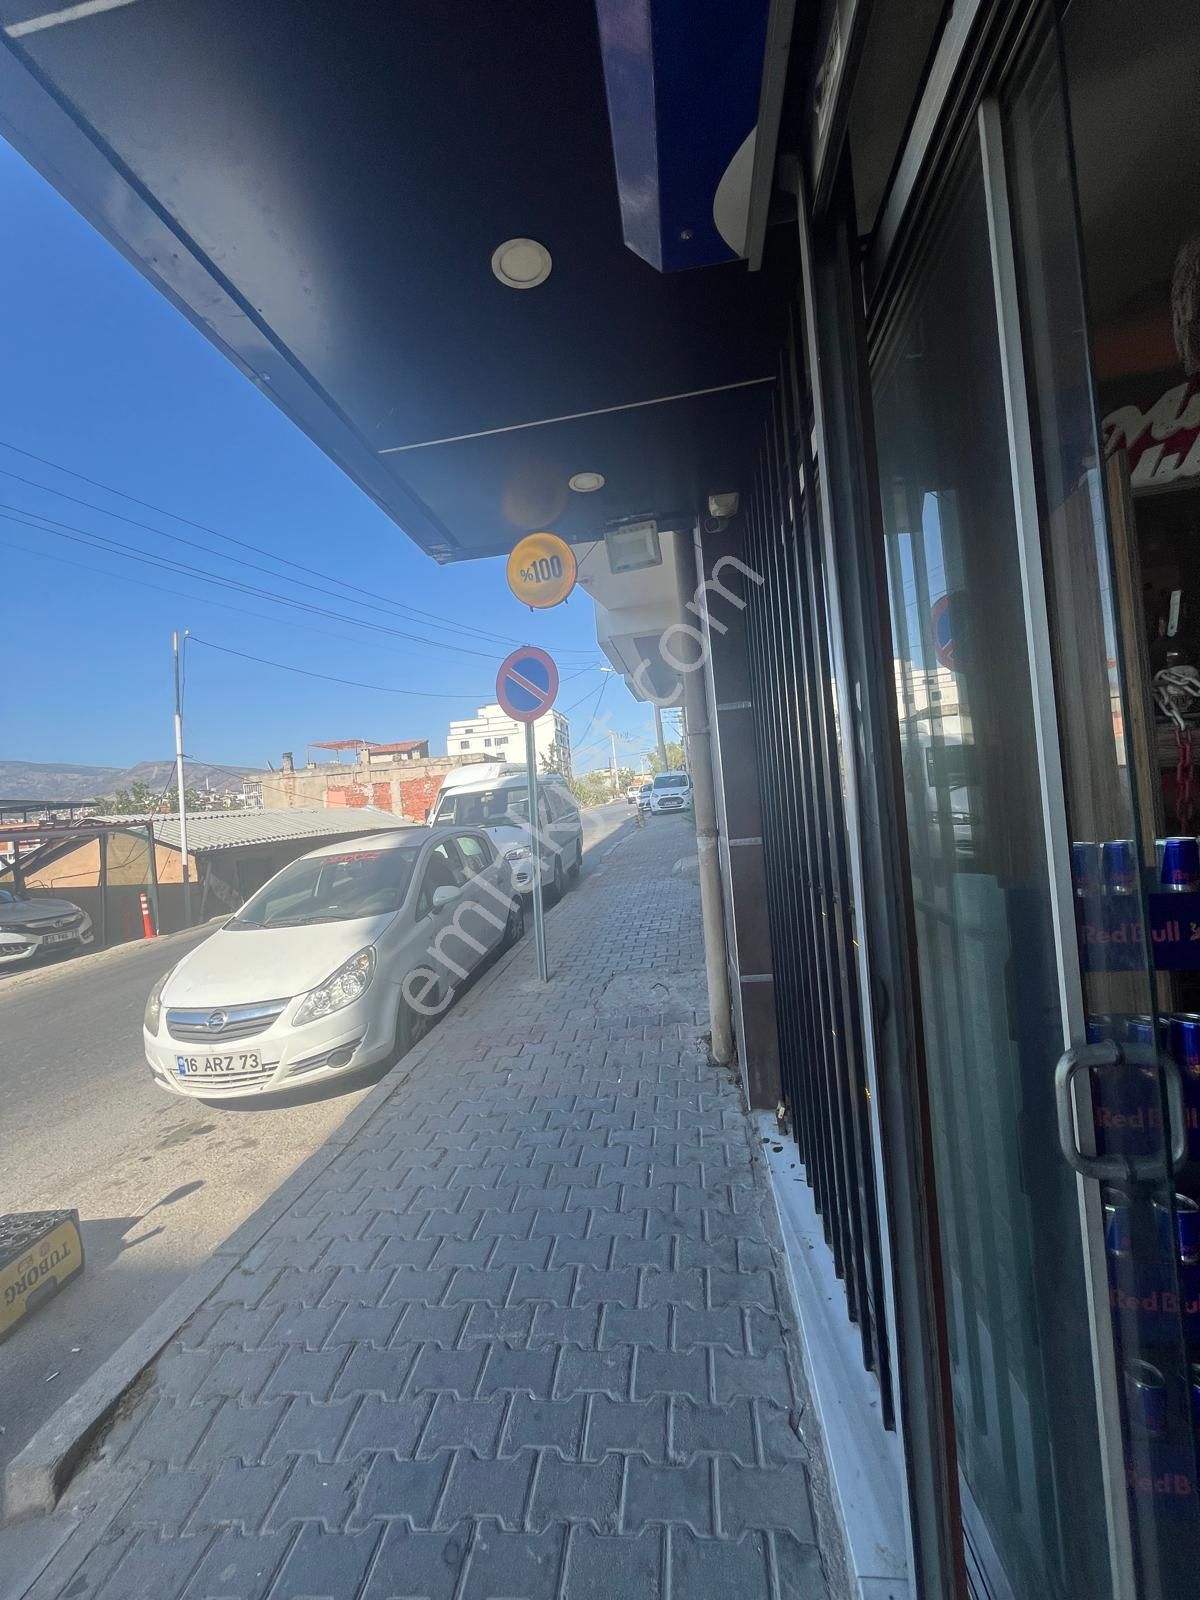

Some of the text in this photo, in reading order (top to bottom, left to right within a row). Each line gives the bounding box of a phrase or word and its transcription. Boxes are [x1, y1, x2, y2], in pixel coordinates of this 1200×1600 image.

[184, 1053, 259, 1072] 16 ARZ 73
[4, 1242, 71, 1305] TUBORG
